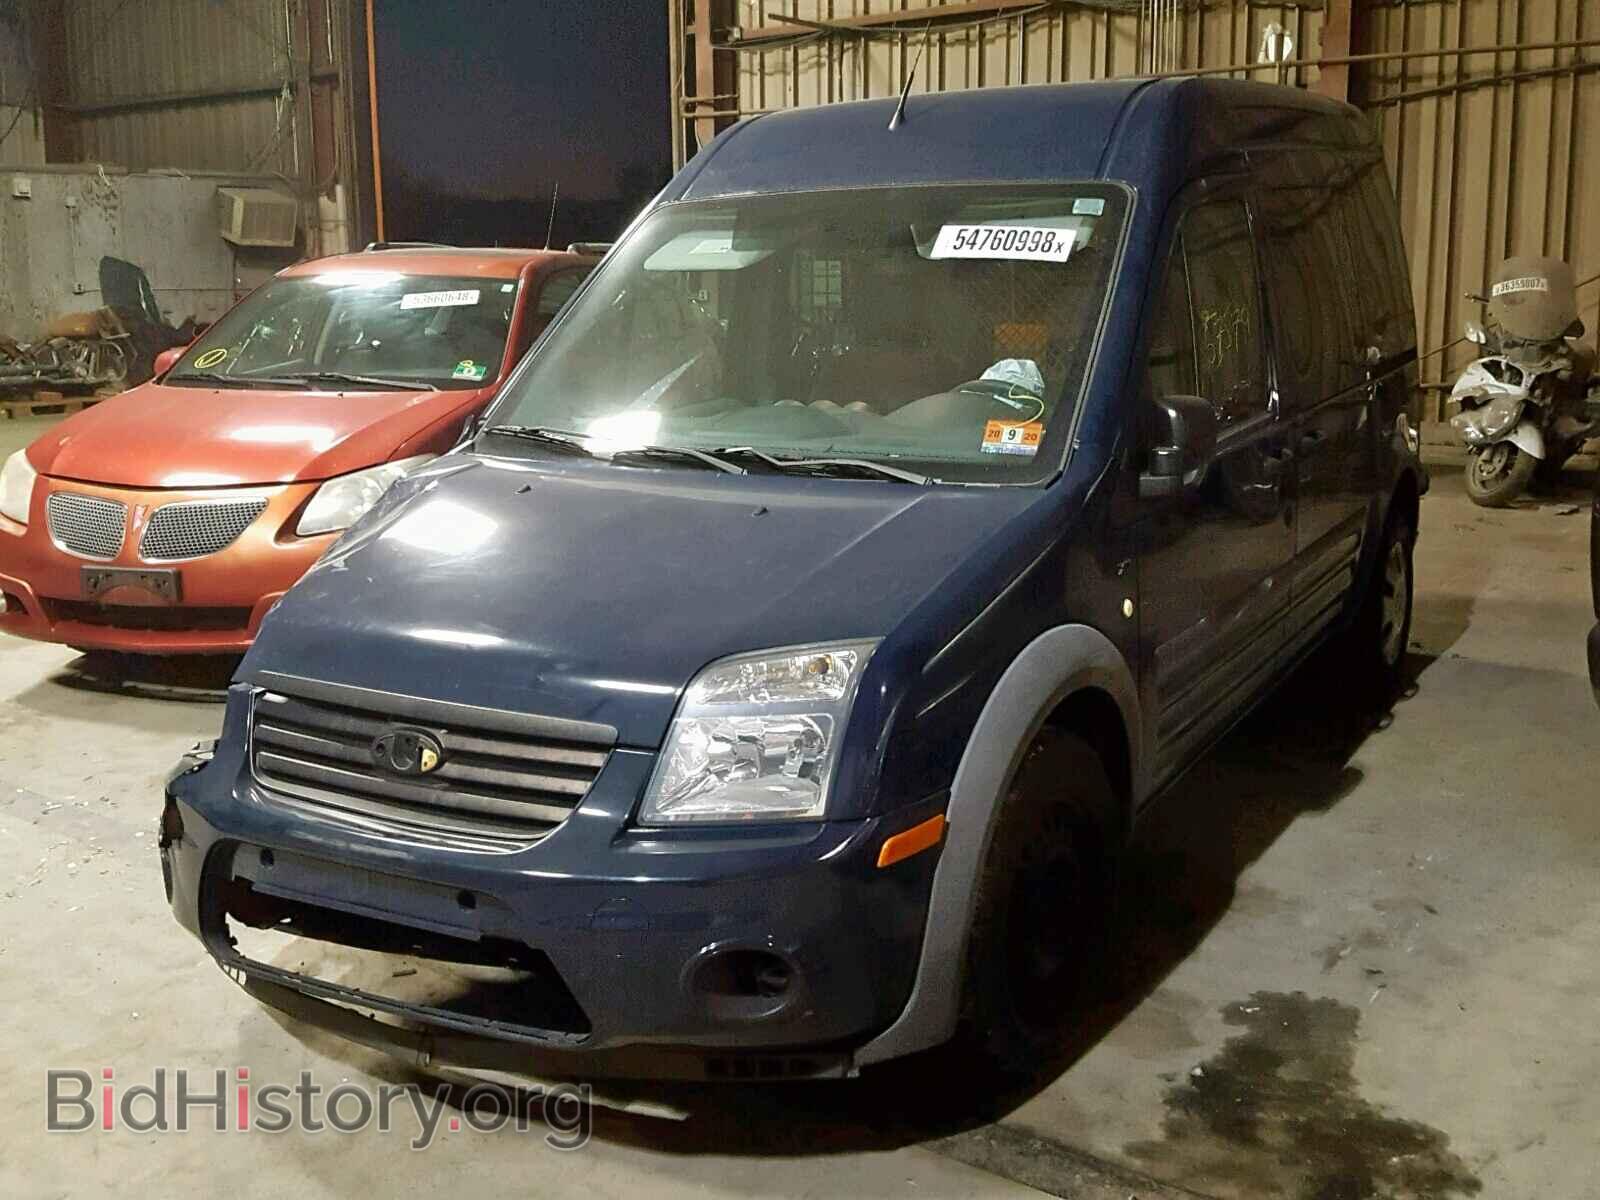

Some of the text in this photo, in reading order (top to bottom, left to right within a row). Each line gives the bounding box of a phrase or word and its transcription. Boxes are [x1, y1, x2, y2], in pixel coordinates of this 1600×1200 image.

[987, 429, 1038, 441] 20 9 20
